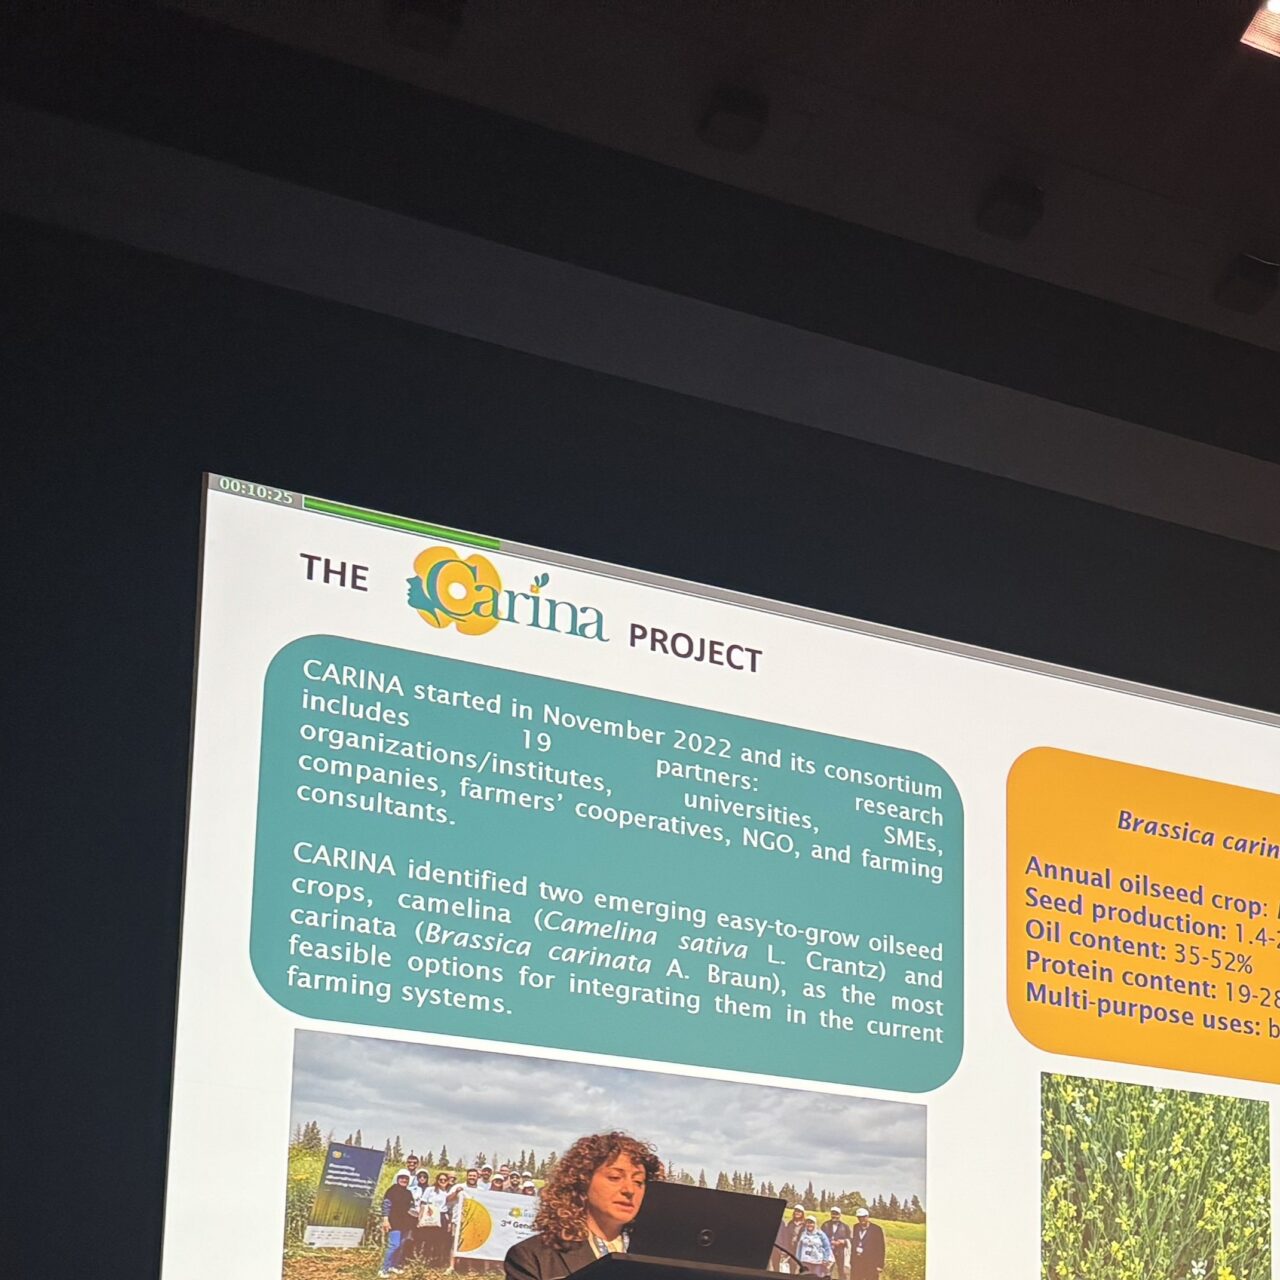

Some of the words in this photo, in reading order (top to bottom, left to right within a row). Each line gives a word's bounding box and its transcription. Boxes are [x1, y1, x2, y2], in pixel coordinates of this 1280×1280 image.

[219, 477, 294, 504] 00:10:25
[300, 553, 369, 592] THE
[424, 558, 611, 643] Carina
[630, 623, 763, 672] PROJECT
[303, 660, 404, 696] CARINA
[414, 685, 501, 714] started
[512, 698, 532, 720] in
[544, 704, 665, 745] November
[674, 730, 731, 758] 2022
[741, 748, 781, 768] and
[791, 753, 816, 774] its
[824, 765, 942, 799] consortium
[303, 689, 409, 727] includes
[523, 729, 551, 752] 19
[656, 759, 758, 791] partners:
[856, 797, 943, 826] research
[297, 785, 455, 825] consultants.
[299, 755, 446, 797] companies,
[460, 777, 562, 811] farmers’
[575, 803, 730, 846] cooperatives,
[743, 827, 800, 858] NGO,
[811, 844, 850, 864] and
[862, 848, 943, 884] farming
[300, 724, 611, 797] organizations/institutes,
[685, 793, 818, 834] universities,
[884, 826, 943, 856] SMEs,
[1118, 810, 1214, 846] Brassica
[294, 842, 396, 876] CARINA
[409, 859, 527, 896] identified
[539, 882, 583, 904] two
[594, 893, 706, 928] emerging
[717, 913, 860, 948] easy-to-grow
[869, 935, 943, 961] oilseed
[1025, 856, 1110, 889] Annual
[1120, 874, 1203, 906] oilseed
[1212, 894, 1267, 919] crop:
[1026, 887, 1082, 915] Seed
[1093, 903, 1226, 940] production:
[290, 909, 396, 937] carinata
[415, 921, 531, 956] (Brassica
[548, 946, 651, 973] carinata
[666, 958, 689, 979] A.
[708, 964, 786, 997] Braun),
[803, 983, 826, 999] as
[841, 984, 875, 1006] the
[892, 996, 944, 1016] most
[292, 878, 372, 907] crops,
[398, 893, 512, 924] camelina
[534, 908, 657, 945] (Camelina
[678, 936, 748, 959] sativa
[768, 944, 785, 965] L.
[806, 951, 886, 982] Crantz)
[905, 970, 942, 989] and
[1026, 919, 1060, 943] Oil
[1069, 931, 1166, 960] content:
[1175, 943, 1253, 974] 35-52%
[1027, 950, 1112, 983] Protein
[1122, 971, 1216, 999] content:
[287, 965, 391, 1003] farming
[402, 986, 512, 1014] systems.
[289, 934, 391, 967] feasible
[408, 956, 503, 982] options
[519, 965, 555, 989] for
[570, 973, 700, 1014] integrating
[714, 994, 771, 1019] them
[787, 1004, 806, 1024] in
[819, 1009, 853, 1031] the
[867, 1020, 943, 1043] current
[1027, 982, 1194, 1026] Multi-purpose
[1203, 1014, 1260, 1036] uses:
